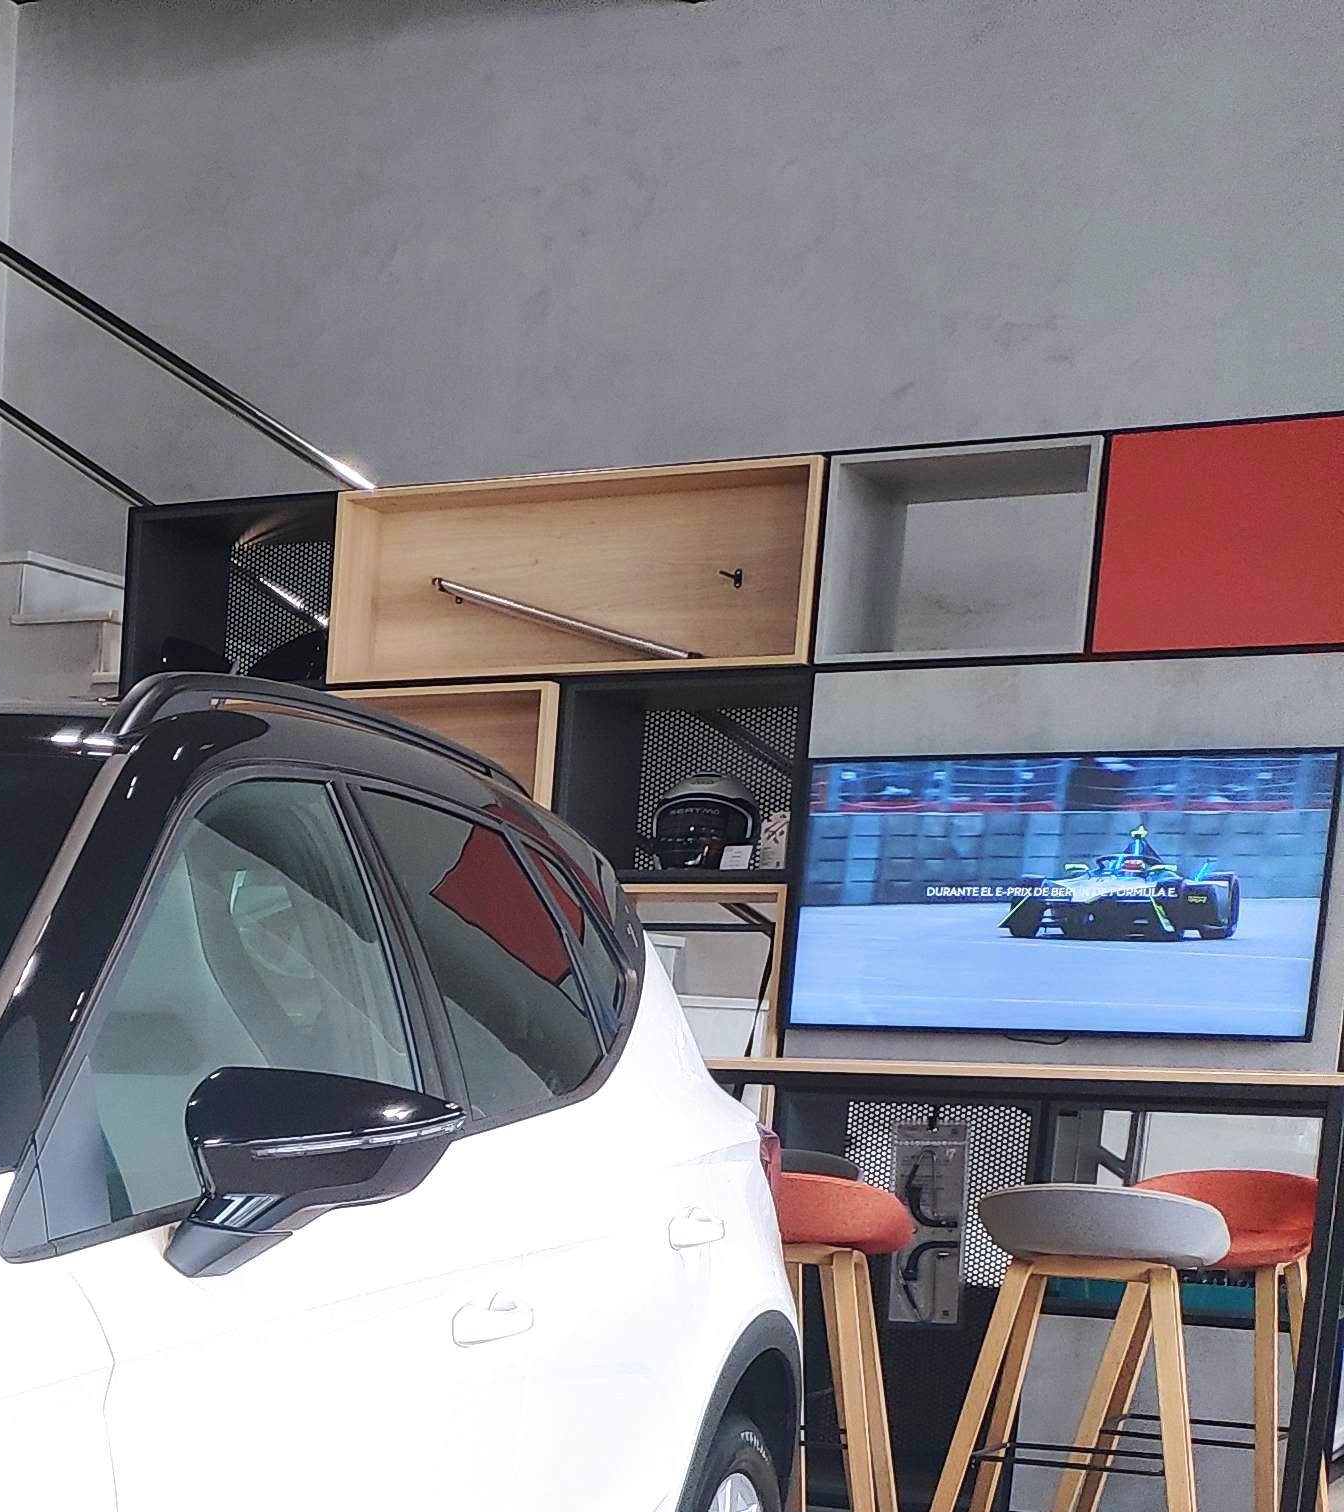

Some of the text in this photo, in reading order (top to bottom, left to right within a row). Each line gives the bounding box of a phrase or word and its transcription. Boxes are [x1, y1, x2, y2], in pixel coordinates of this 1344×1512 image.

[926, 886, 979, 897] DURANTE
[980, 886, 993, 897] EL
[995, 886, 1032, 897] E-PRIX
[1033, 886, 1049, 897] DE
